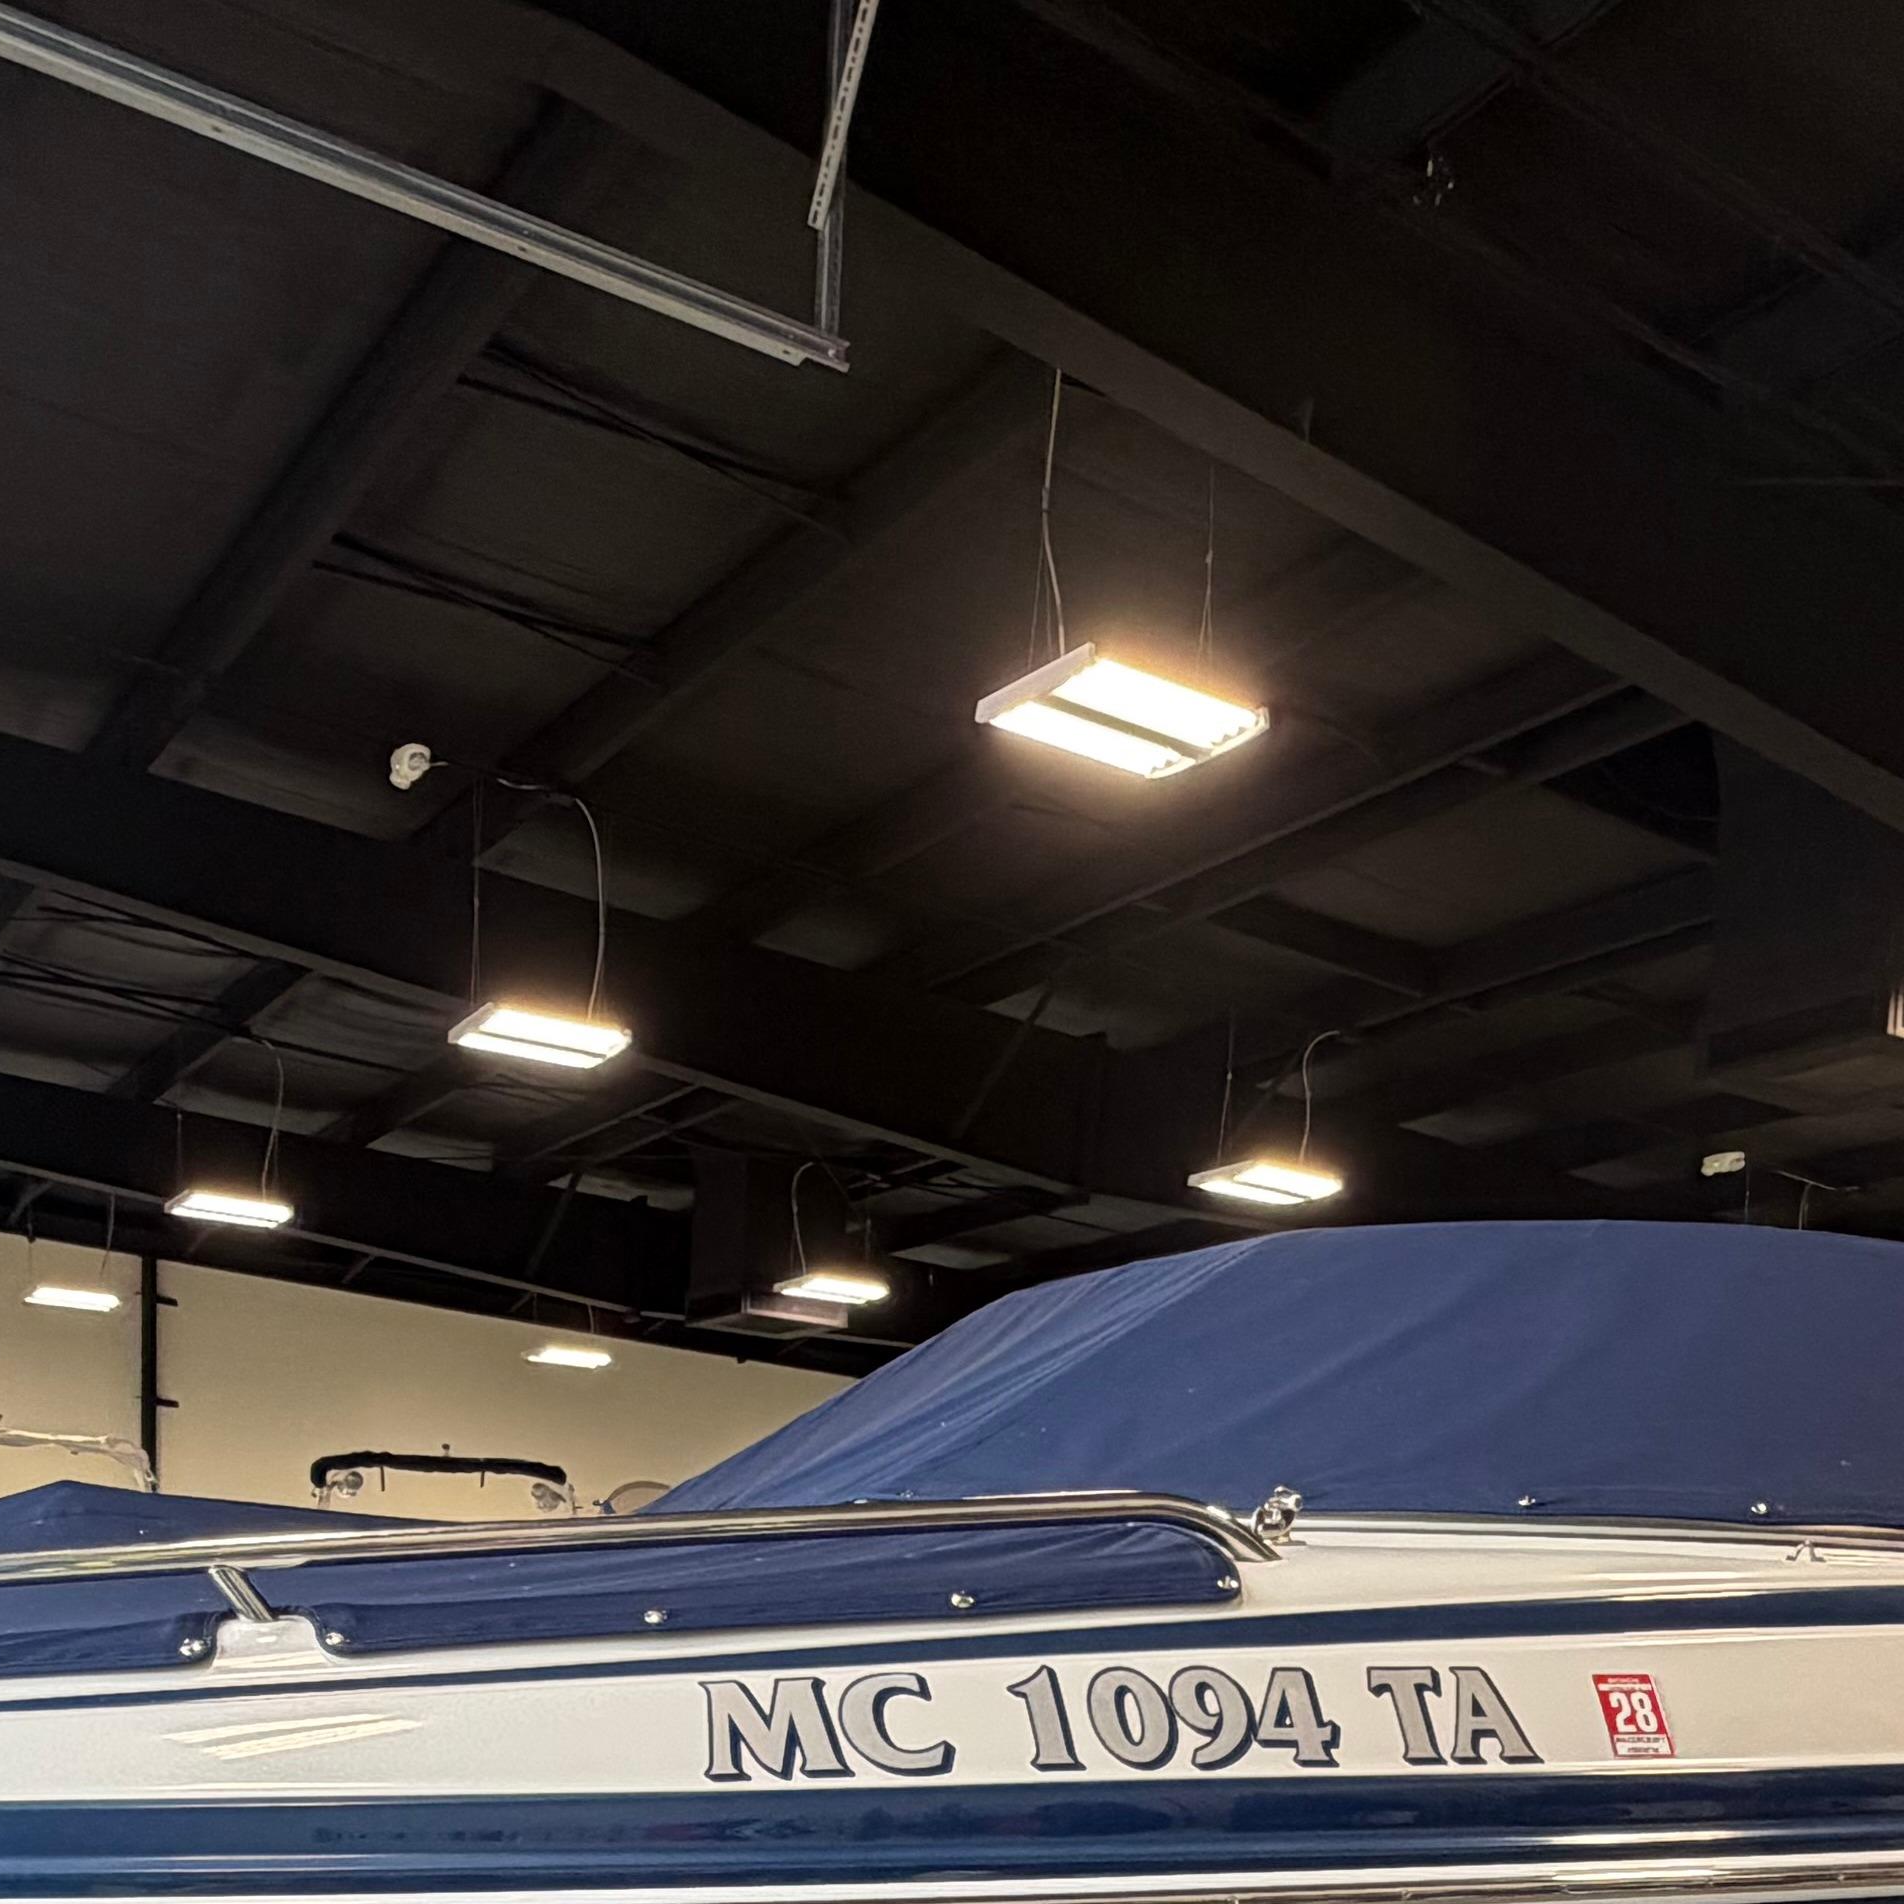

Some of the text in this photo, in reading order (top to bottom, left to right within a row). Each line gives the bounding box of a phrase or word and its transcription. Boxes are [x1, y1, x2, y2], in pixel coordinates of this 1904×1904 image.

[699, 1664, 1545, 1781] MC 1094 TA
[1609, 1691, 1658, 1733] 28
